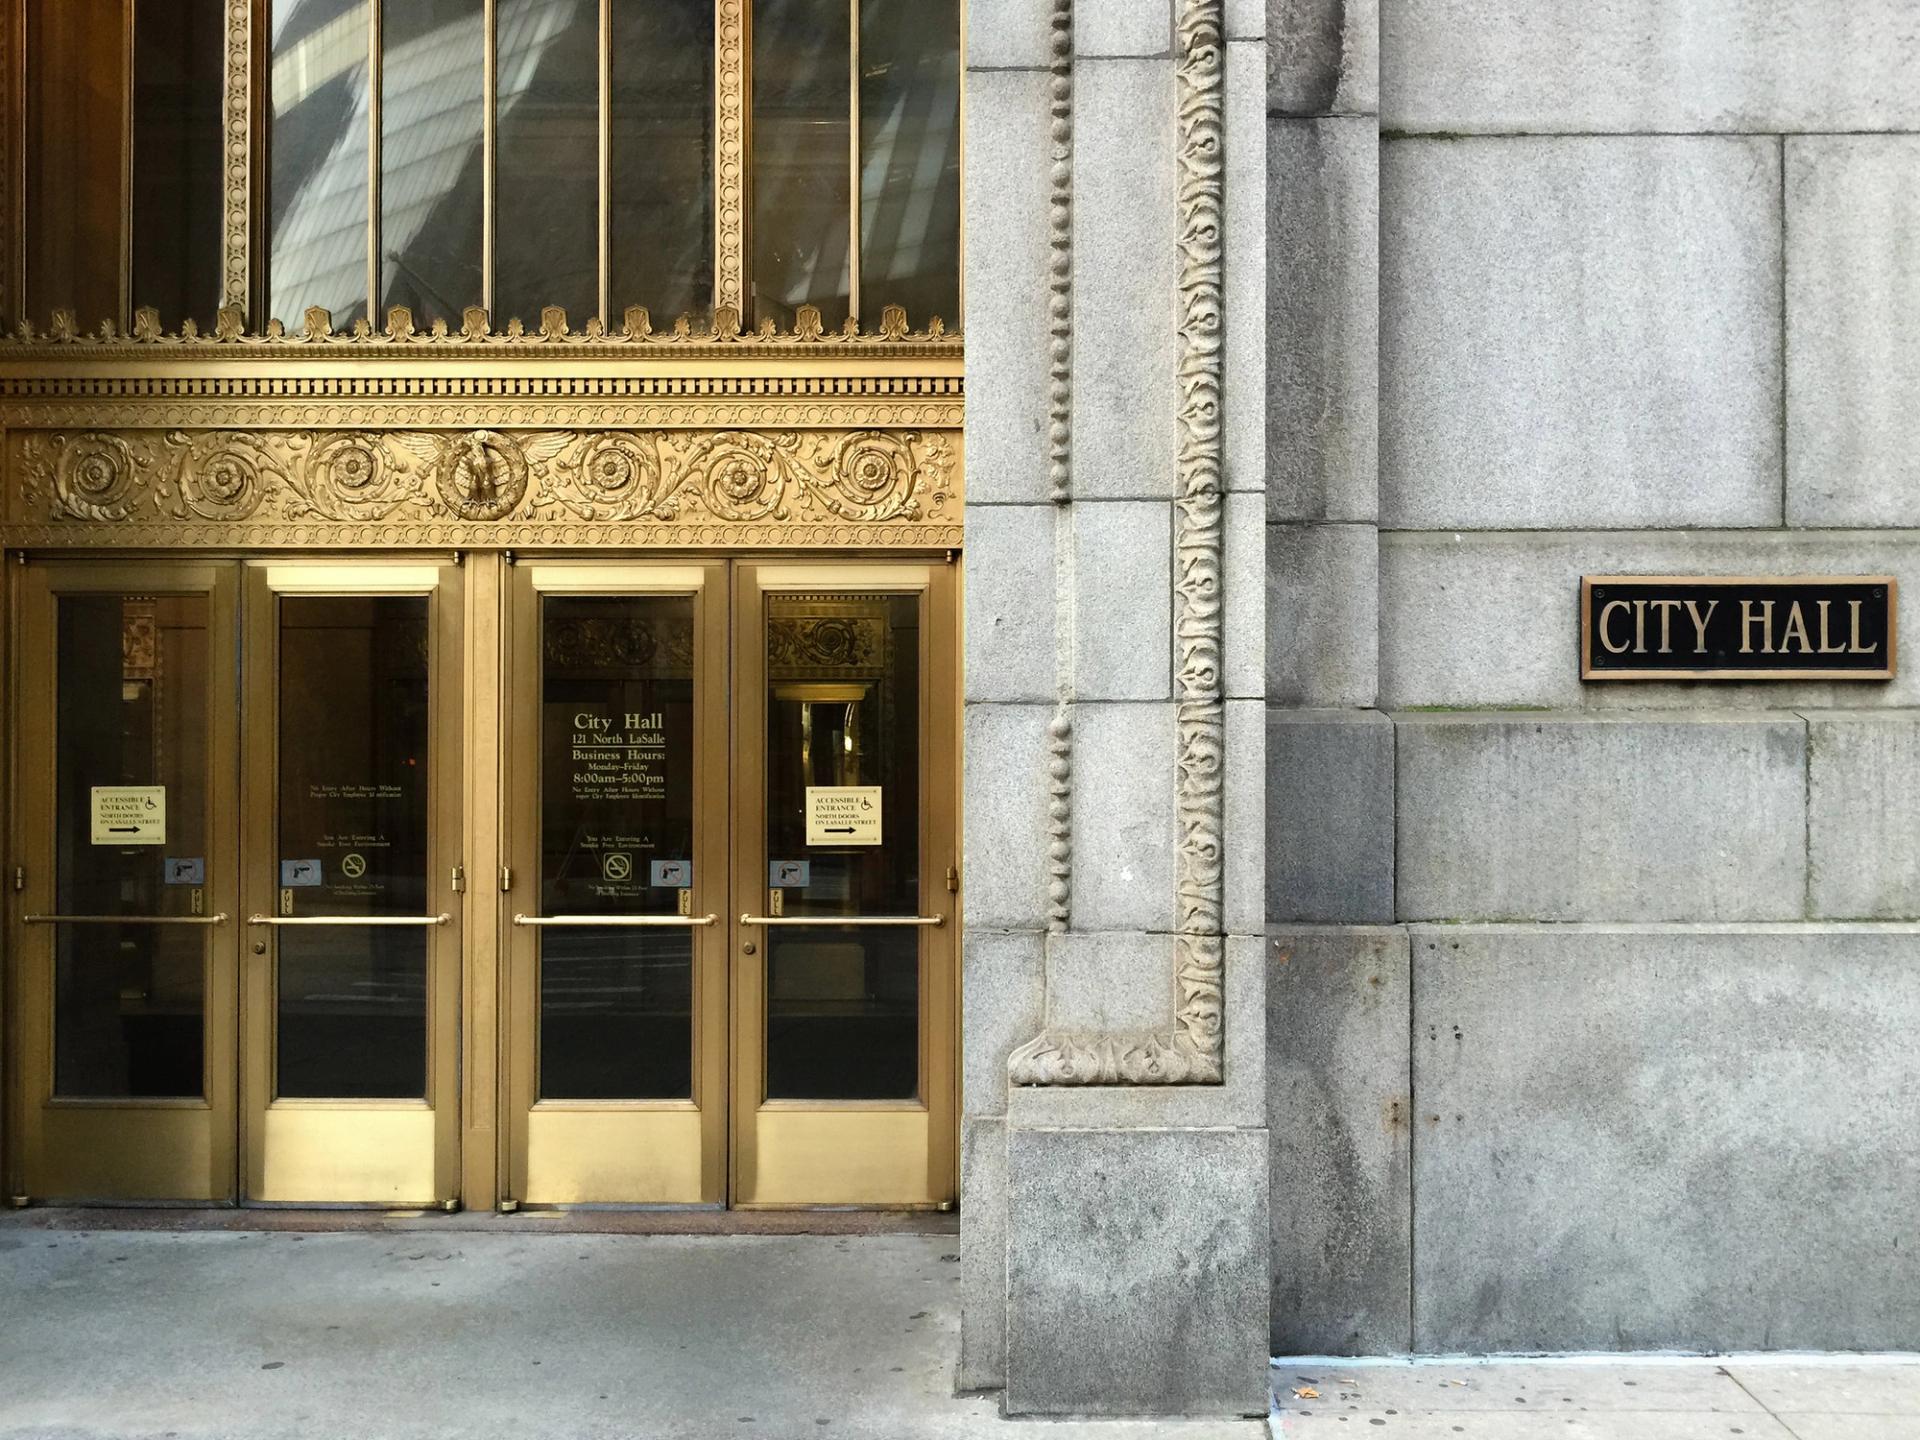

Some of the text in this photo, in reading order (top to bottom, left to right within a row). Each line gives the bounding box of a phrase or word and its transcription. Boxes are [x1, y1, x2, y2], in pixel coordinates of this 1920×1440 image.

[1599, 599, 1879, 655] CITY HALL
[574, 712, 664, 733] City Hall
[572, 733, 666, 745] 121 North LaSalle
[572, 749, 666, 761] Business Hours:
